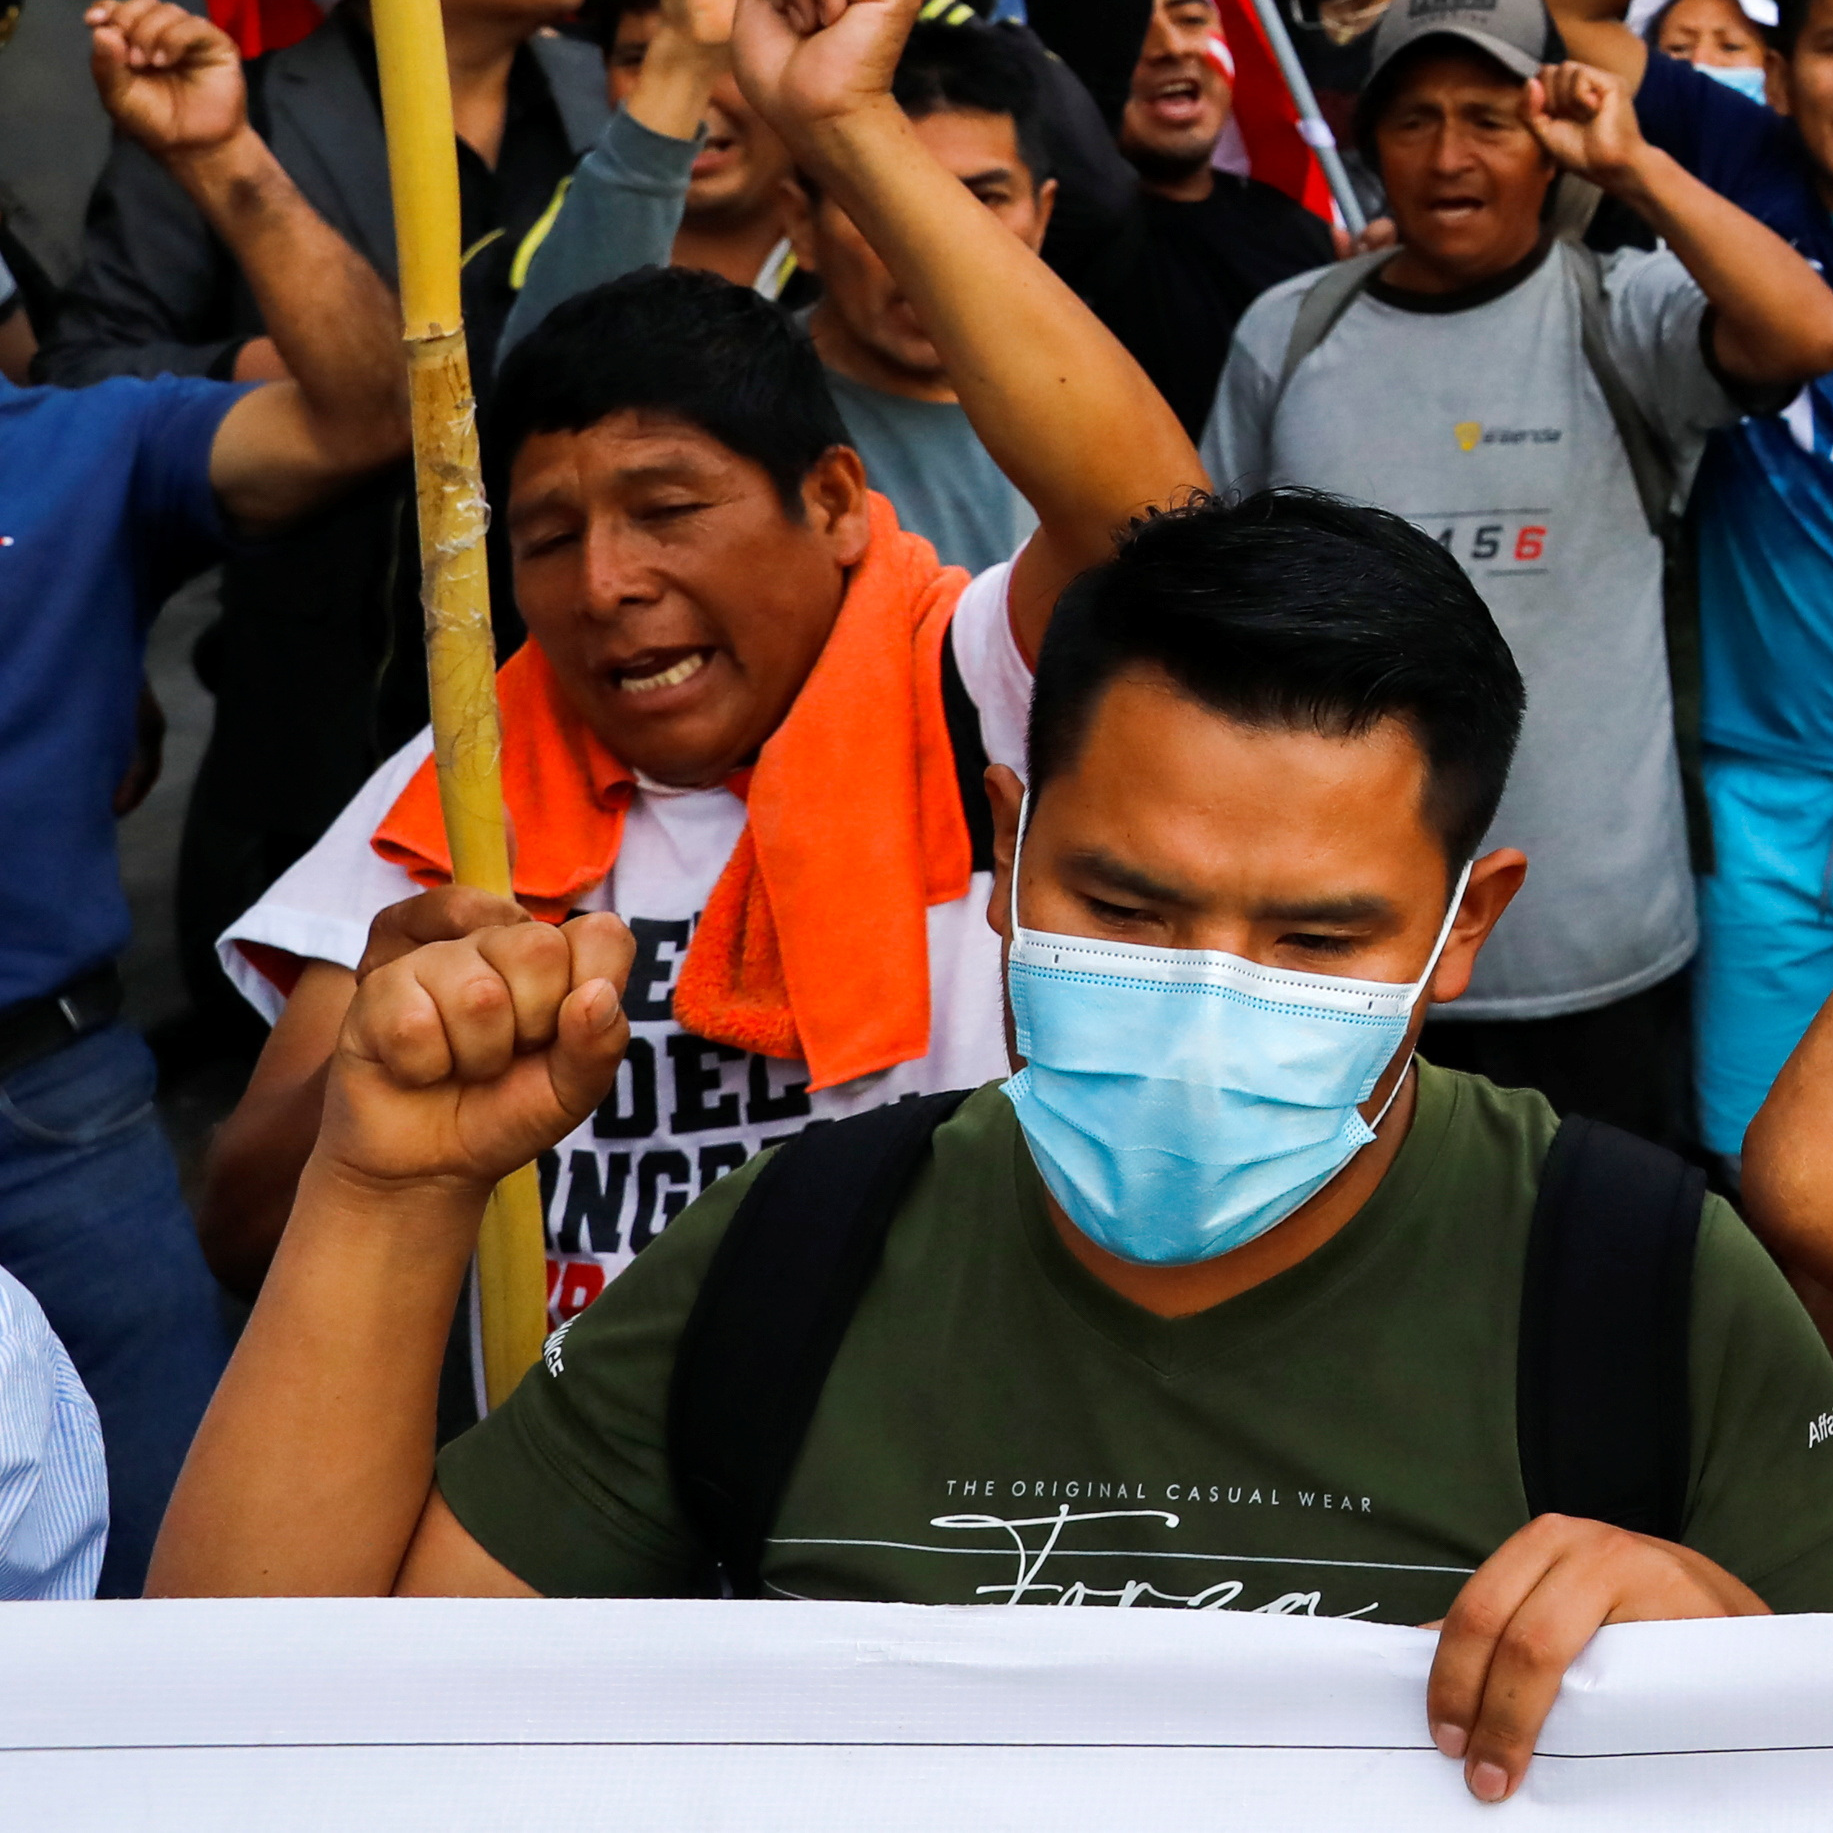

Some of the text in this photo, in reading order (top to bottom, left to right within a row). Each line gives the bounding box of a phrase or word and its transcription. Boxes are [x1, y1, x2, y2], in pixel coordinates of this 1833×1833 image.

[592, 1033, 813, 1141] DEL
[946, 1480, 1373, 1512] THE ORIGINAL CASUAL WEAR
